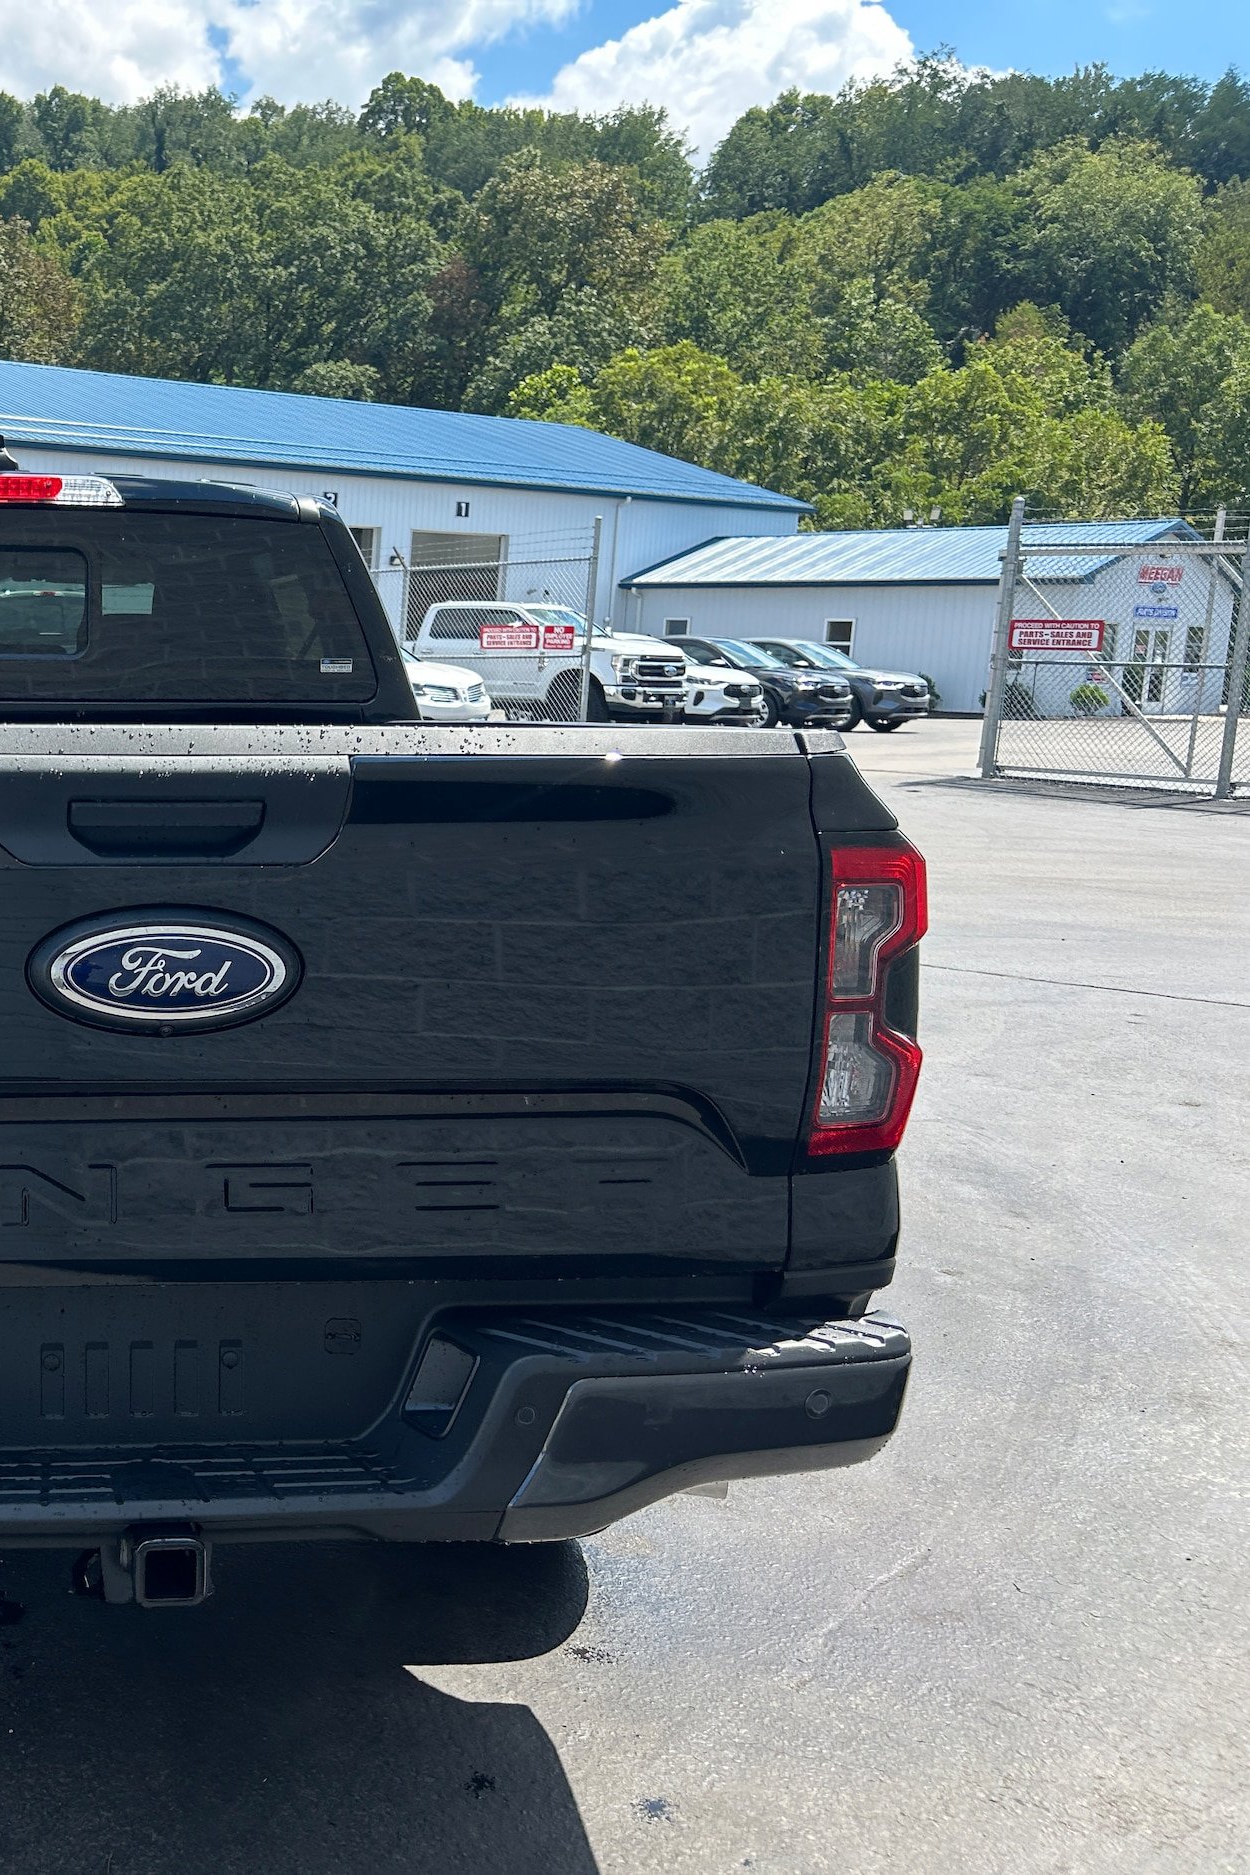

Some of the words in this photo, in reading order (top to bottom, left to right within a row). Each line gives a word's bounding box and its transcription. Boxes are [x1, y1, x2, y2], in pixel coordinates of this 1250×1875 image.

[460, 502, 467, 516] 1
[1139, 565, 1184, 581] MEEGAN
[553, 626, 565, 634] NO
[1075, 631, 1093, 639] AND
[1017, 638, 1050, 646] SERVICE
[1051, 638, 1092, 647] ENTRANCE
[108, 946, 232, 997] Ford
